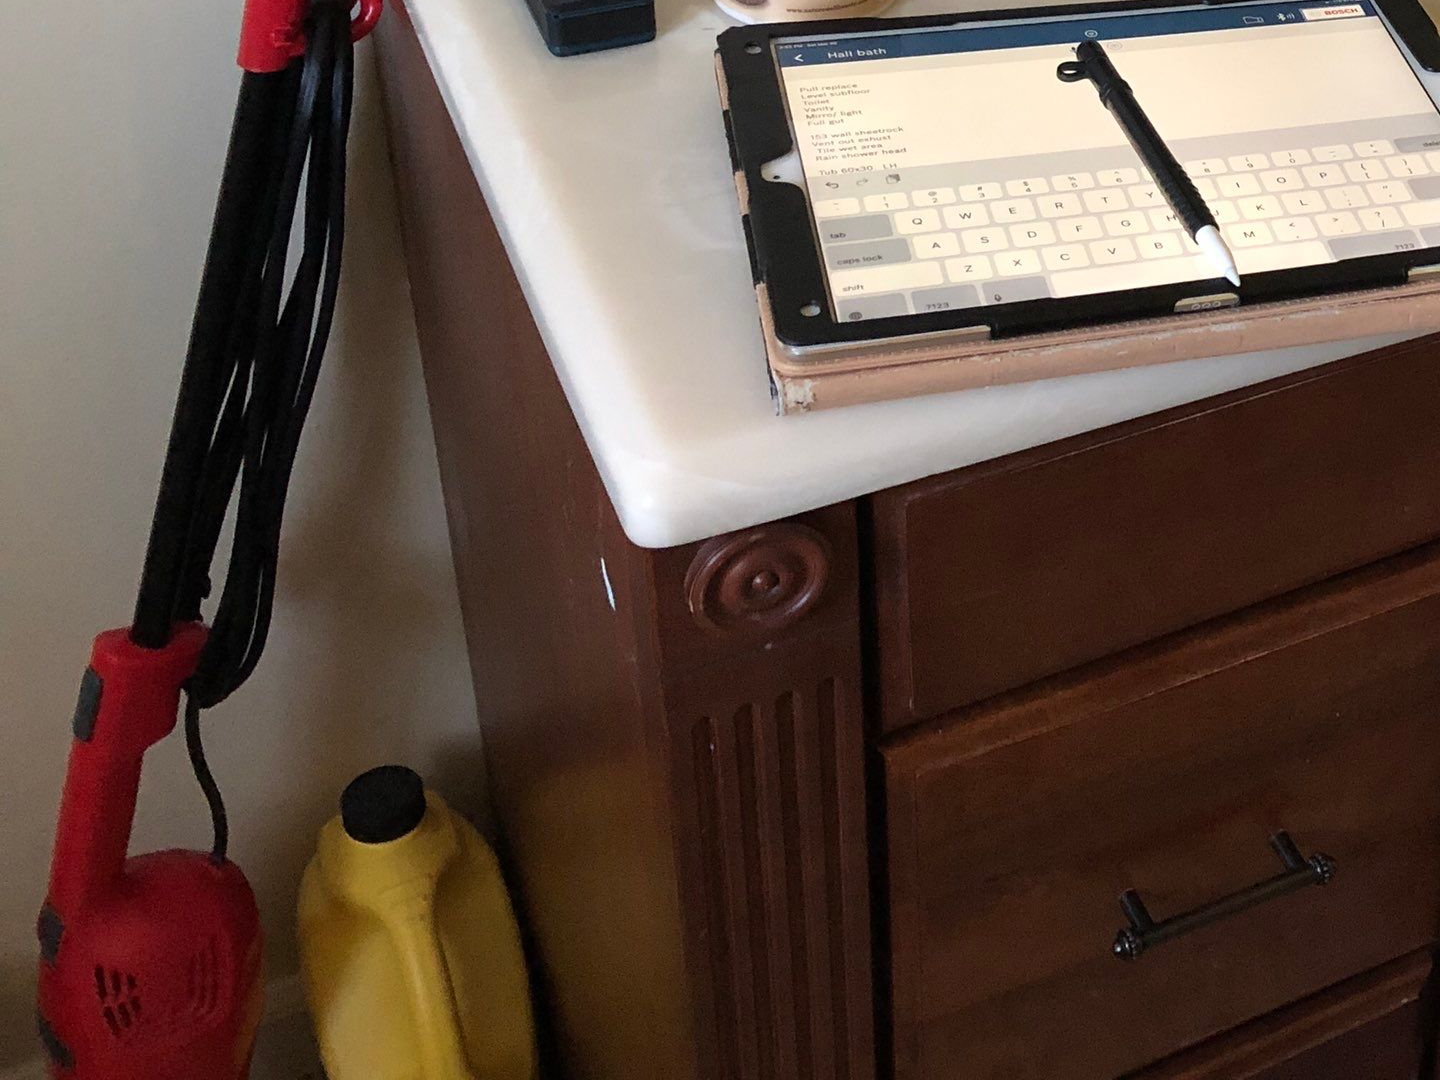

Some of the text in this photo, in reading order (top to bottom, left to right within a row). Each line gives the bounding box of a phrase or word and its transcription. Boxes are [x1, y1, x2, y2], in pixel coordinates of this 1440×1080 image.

[1324, 7, 1359, 16] BOSCH
[827, 47, 887, 59] Hall bath
[821, 83, 858, 93] replace
[800, 88, 870, 100] Level subfloor
[804, 105, 834, 113] Vanity
[840, 109, 863, 118] light
[829, 118, 844, 126] gut
[854, 126, 904, 136] sheetrock
[841, 150, 878, 159] shower
[881, 147, 907, 155] head
[819, 168, 838, 176] Tub
[912, 217, 923, 225] Q
[959, 212, 972, 220] W
[1055, 201, 1064, 209] R
[1101, 196, 1109, 204] T
[1146, 191, 1153, 199] Y
[1276, 176, 1287, 184] O
[837, 256, 860, 266] caps
[980, 236, 989, 244] S
[1027, 230, 1037, 238] D
[1121, 219, 1131, 227] G
[1167, 214, 1177, 222] H
[842, 283, 865, 292] shift
[965, 265, 973, 273] Z
[1060, 253, 1071, 261] C
[1107, 247, 1116, 255] V
[926, 302, 950, 310] ?123
